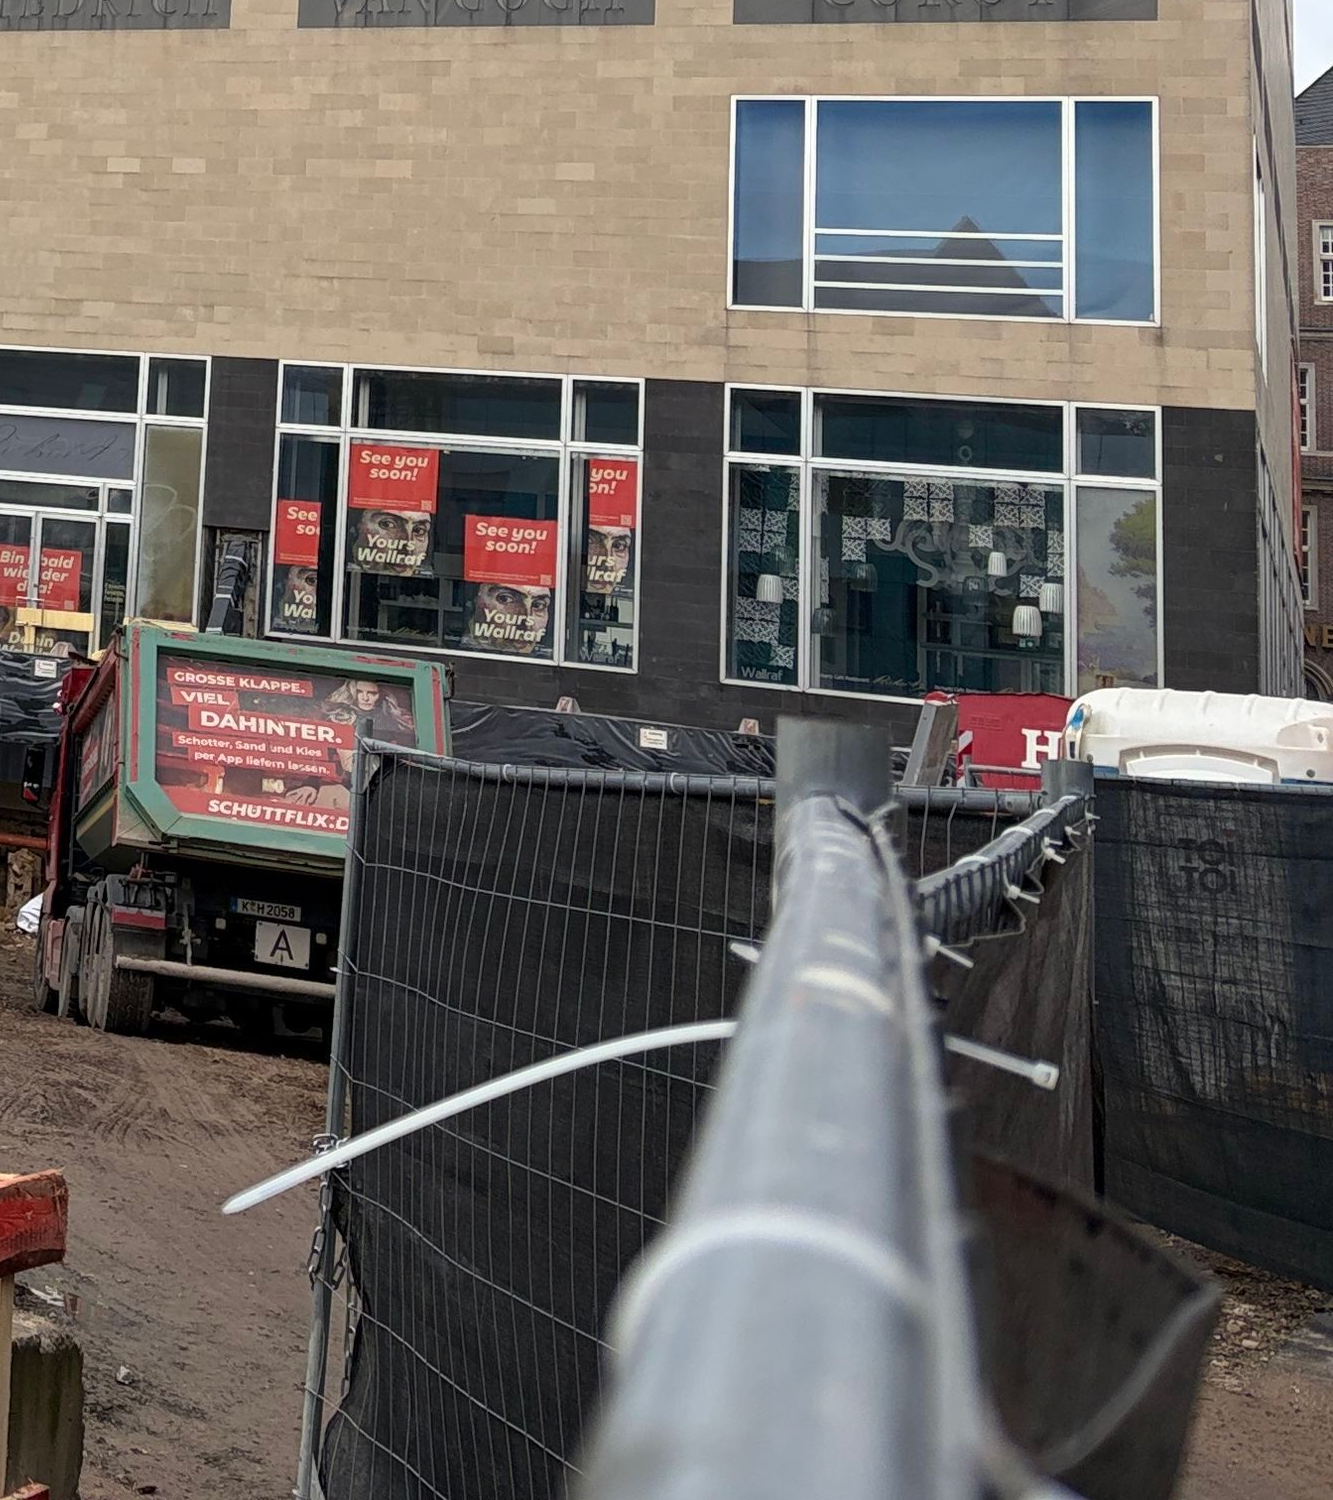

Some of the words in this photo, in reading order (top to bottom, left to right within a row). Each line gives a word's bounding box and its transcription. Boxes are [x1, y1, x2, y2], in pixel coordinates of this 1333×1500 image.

[359, 450, 391, 465] See
[395, 455, 428, 468] you
[369, 468, 418, 481] soon!
[590, 468, 628, 482] you
[287, 507, 318, 521] See
[476, 522, 507, 537] See
[511, 528, 547, 541] you
[367, 533, 416, 551] Yours
[485, 539, 537, 554] soon!
[0, 550, 24, 564] Bin
[357, 548, 427, 566] Wallraf
[484, 608, 535, 626] Yours
[475, 623, 546, 643] Wallraf
[174, 671, 235, 686] GROSSE
[239, 678, 305, 693] KLAPPE.
[741, 666, 784, 681] Wallraf
[180, 690, 231, 705] VIEL
[200, 710, 342, 744] DAHINTER.
[178, 735, 232, 750] Schotter,
[235, 740, 266, 752] Sand
[194, 751, 214, 764] per
[218, 754, 243, 766] App
[246, 756, 284, 769] liefern
[270, 929, 293, 960] A
